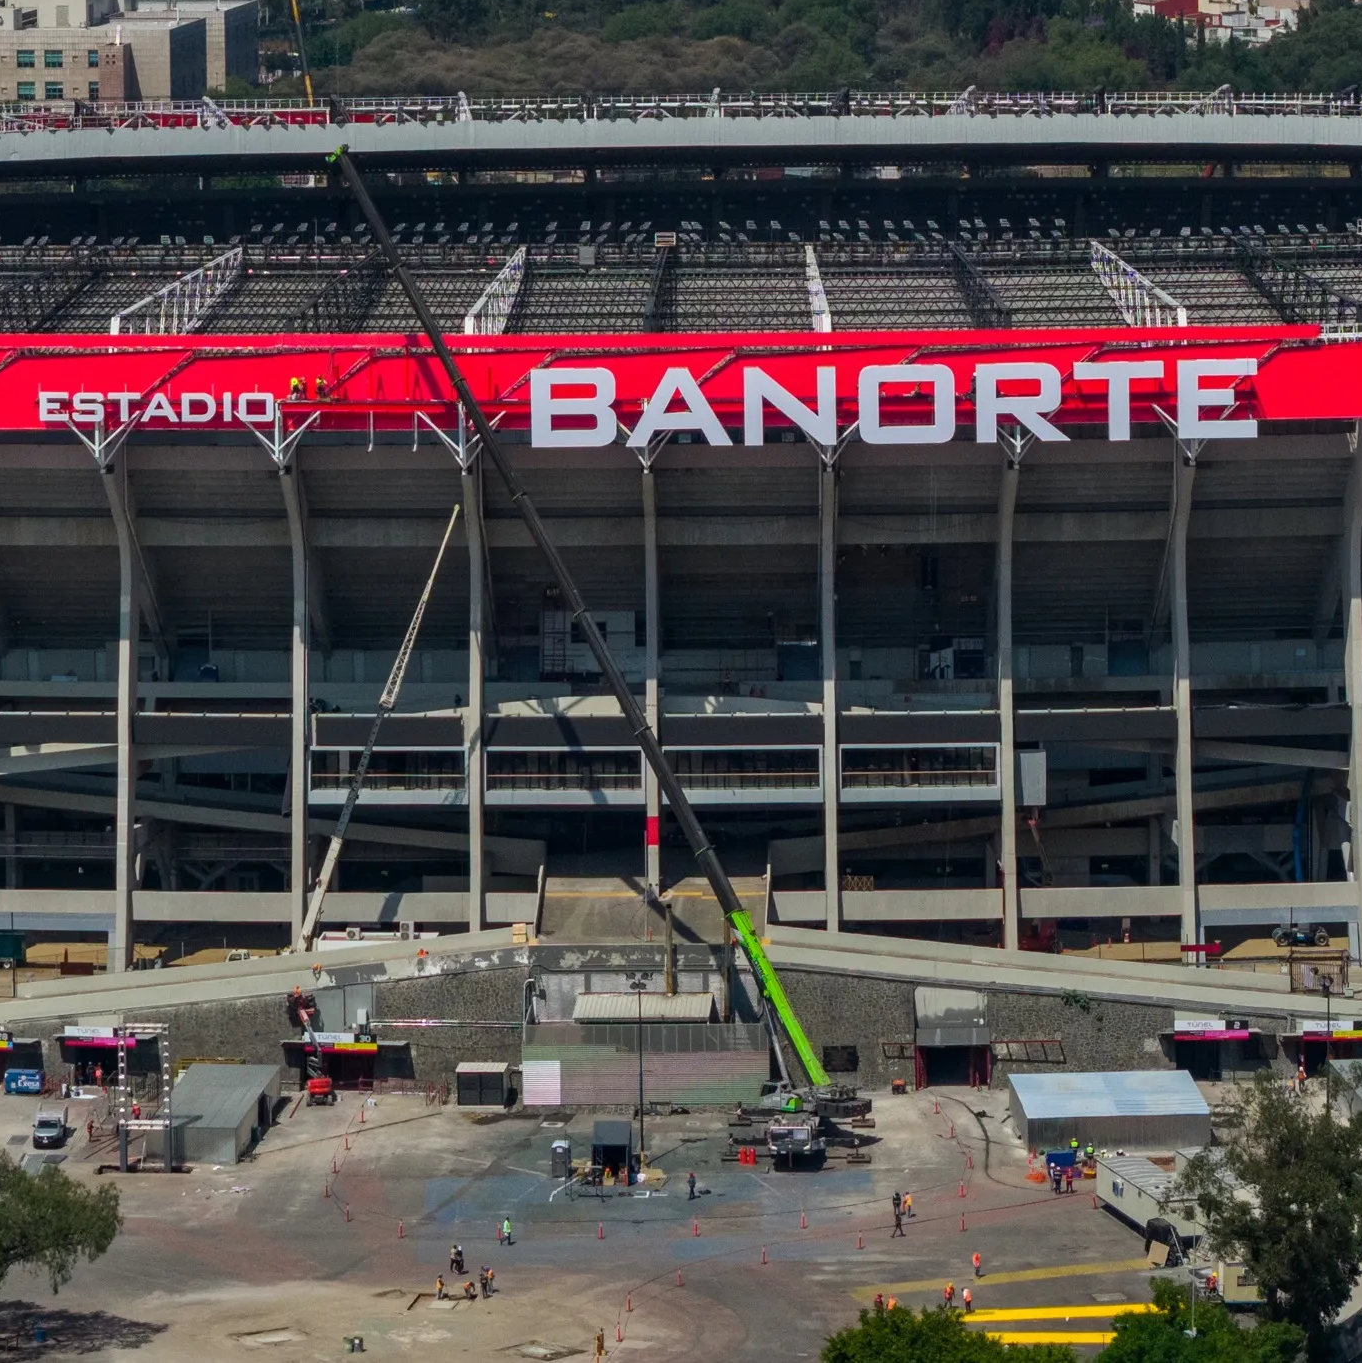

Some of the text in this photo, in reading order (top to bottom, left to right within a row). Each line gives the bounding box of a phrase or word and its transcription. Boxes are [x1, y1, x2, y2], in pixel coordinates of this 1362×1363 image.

[39, 358, 1258, 448] ESTADIO BANORTE
[1234, 1021, 1241, 1030] 2
